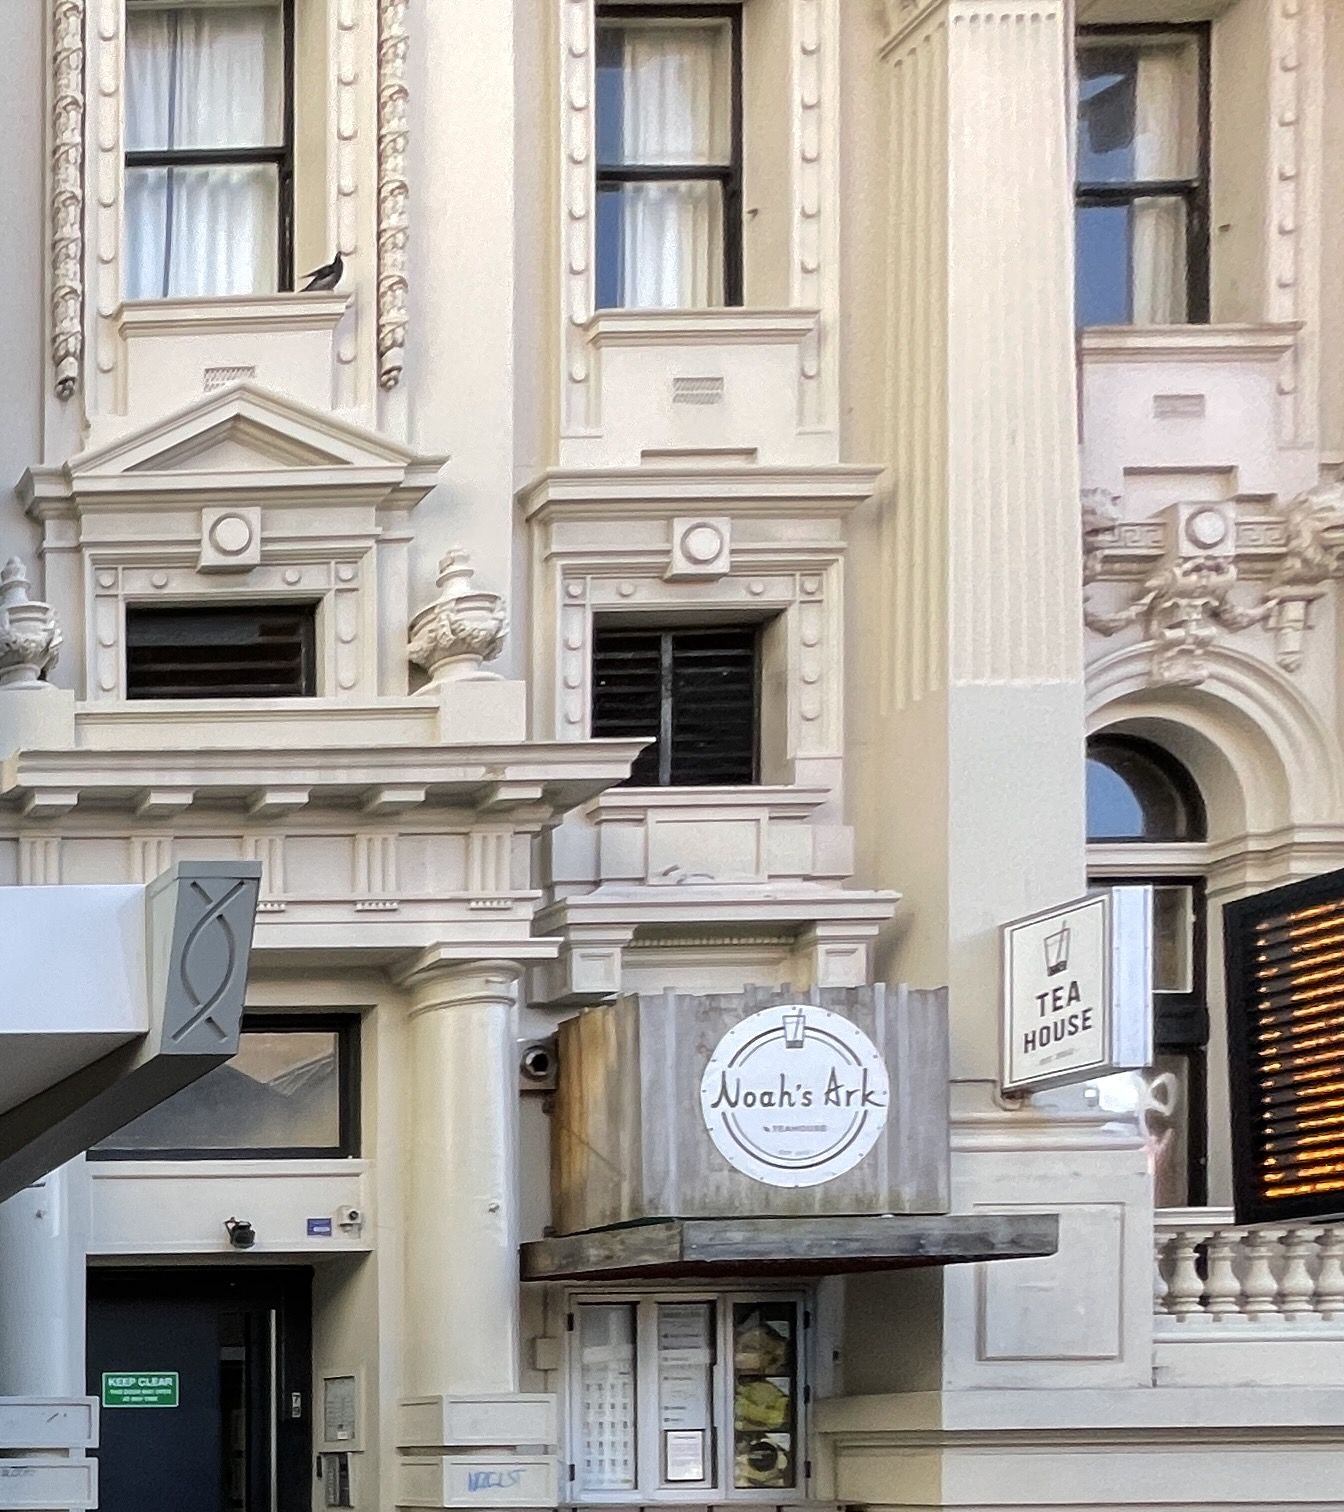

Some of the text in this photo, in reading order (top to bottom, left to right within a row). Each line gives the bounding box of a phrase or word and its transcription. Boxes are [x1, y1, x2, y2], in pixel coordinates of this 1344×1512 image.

[1036, 981, 1081, 1017] TEA
[1023, 1007, 1093, 1054] HOUSE
[711, 1066, 886, 1109] Noah's Ark
[108, 1377, 173, 1387] KEEP CLEAR
